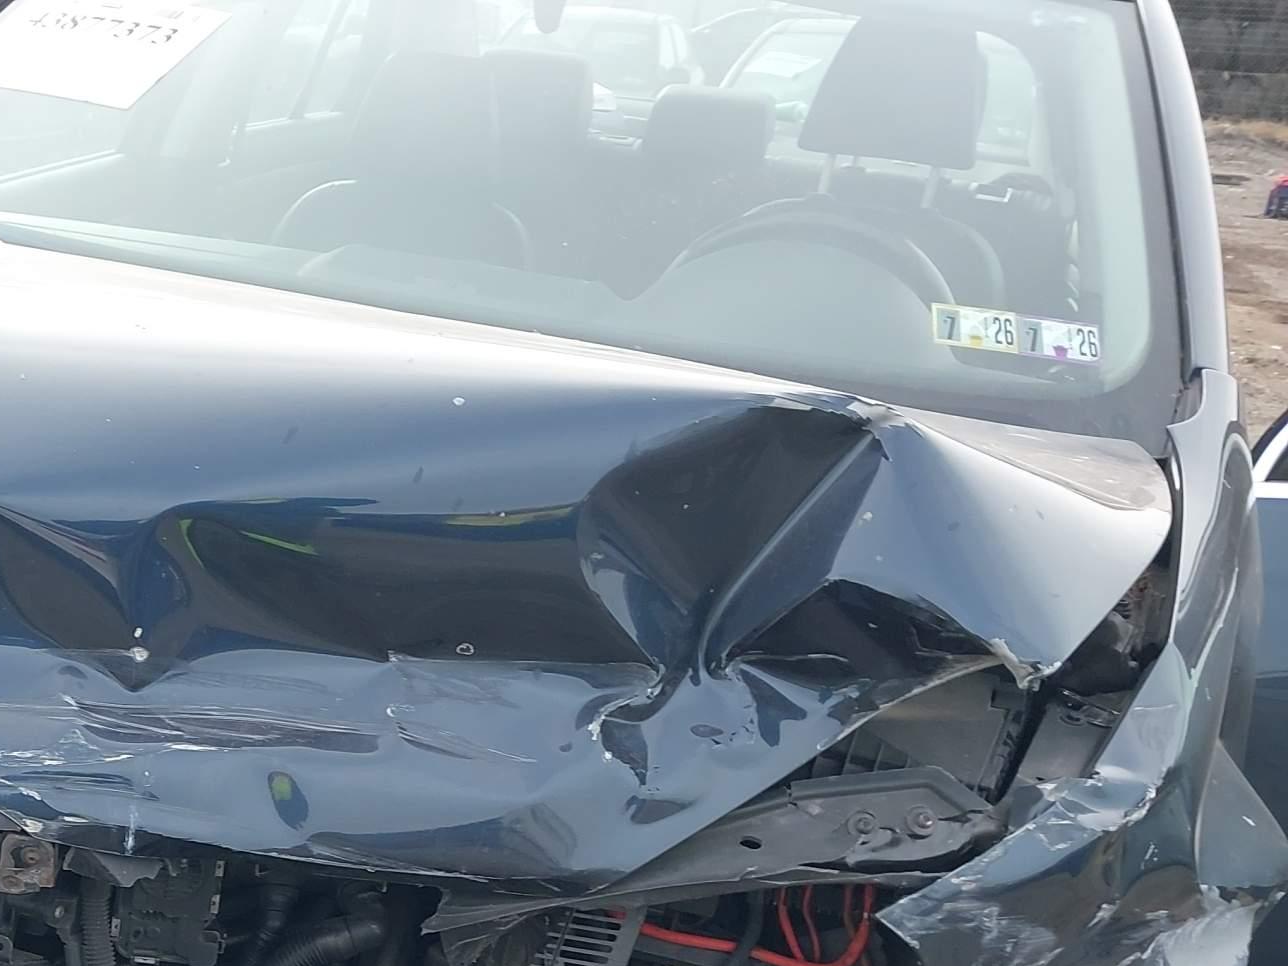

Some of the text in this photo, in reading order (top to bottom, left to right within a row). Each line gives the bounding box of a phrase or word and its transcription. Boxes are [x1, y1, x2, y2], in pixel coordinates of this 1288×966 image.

[943, 315, 956, 340] 7
[992, 316, 1015, 346] 26
[1025, 327, 1039, 352] 7
[1076, 328, 1099, 358] 26
